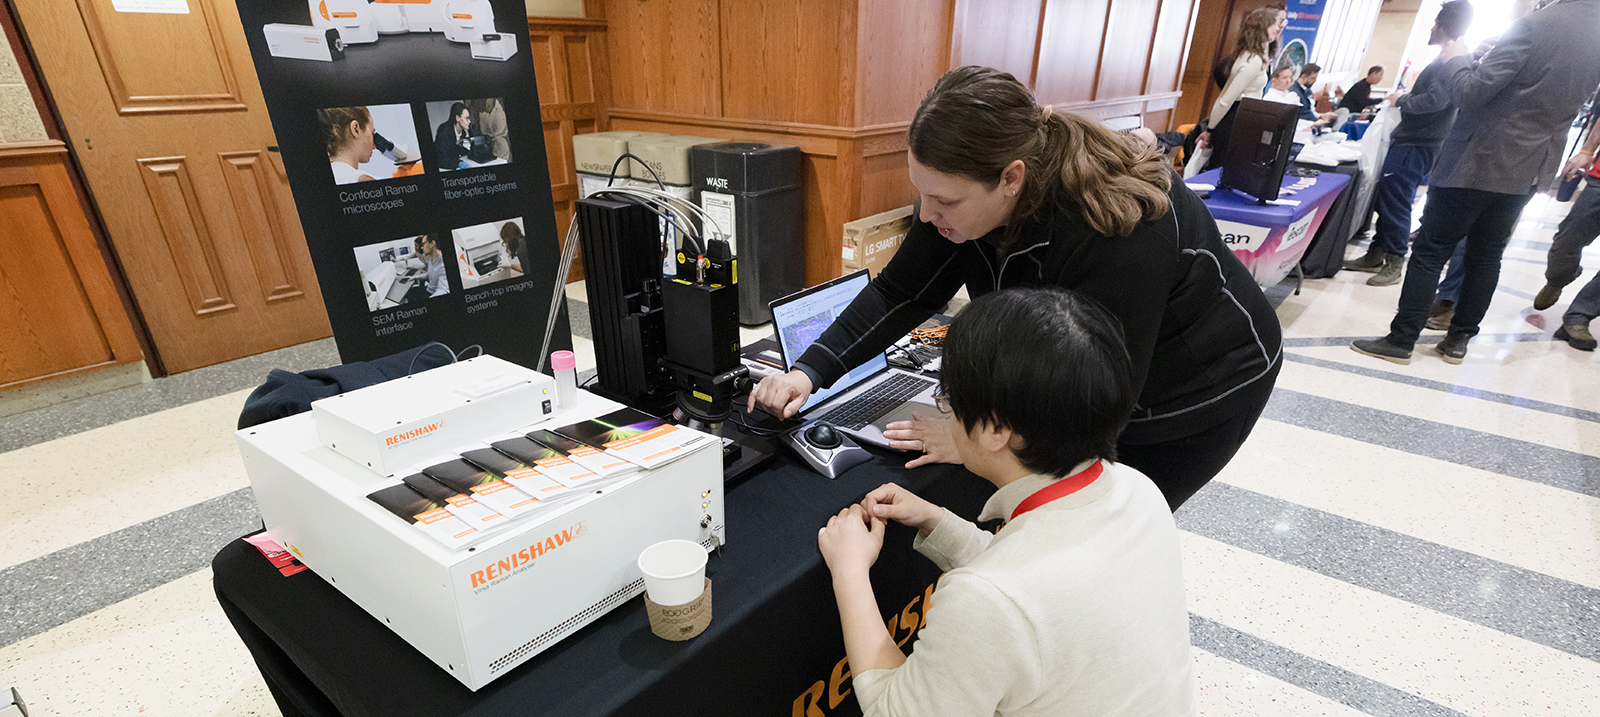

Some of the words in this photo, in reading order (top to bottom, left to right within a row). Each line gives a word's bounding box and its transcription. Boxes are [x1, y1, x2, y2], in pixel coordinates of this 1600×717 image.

[580, 162, 613, 173] NEWSPAPER
[641, 169, 667, 181] BOES
[441, 173, 497, 188] Transportable
[706, 177, 729, 189] WASTE
[339, 187, 384, 203] Confocal
[385, 183, 419, 197] Raman
[443, 186, 485, 200] fiber-optic
[485, 181, 518, 196] systems
[343, 199, 405, 215] microscopes
[865, 243, 875, 257] LG
[875, 236, 898, 253] SMART
[1220, 233, 1250, 245] an
[464, 287, 504, 303] Bench-top
[505, 280, 534, 294] imaging
[466, 300, 499, 314] systems
[372, 312, 395, 326] SEM
[396, 306, 428, 320] Raman
[375, 320, 414, 336] interface
[385, 422, 438, 446] RENISHAW
[470, 526, 573, 589] RENISHAW
[473, 584, 490, 595] Virsa
[490, 573, 512, 586] Raman
[511, 562, 537, 576] Analyser
